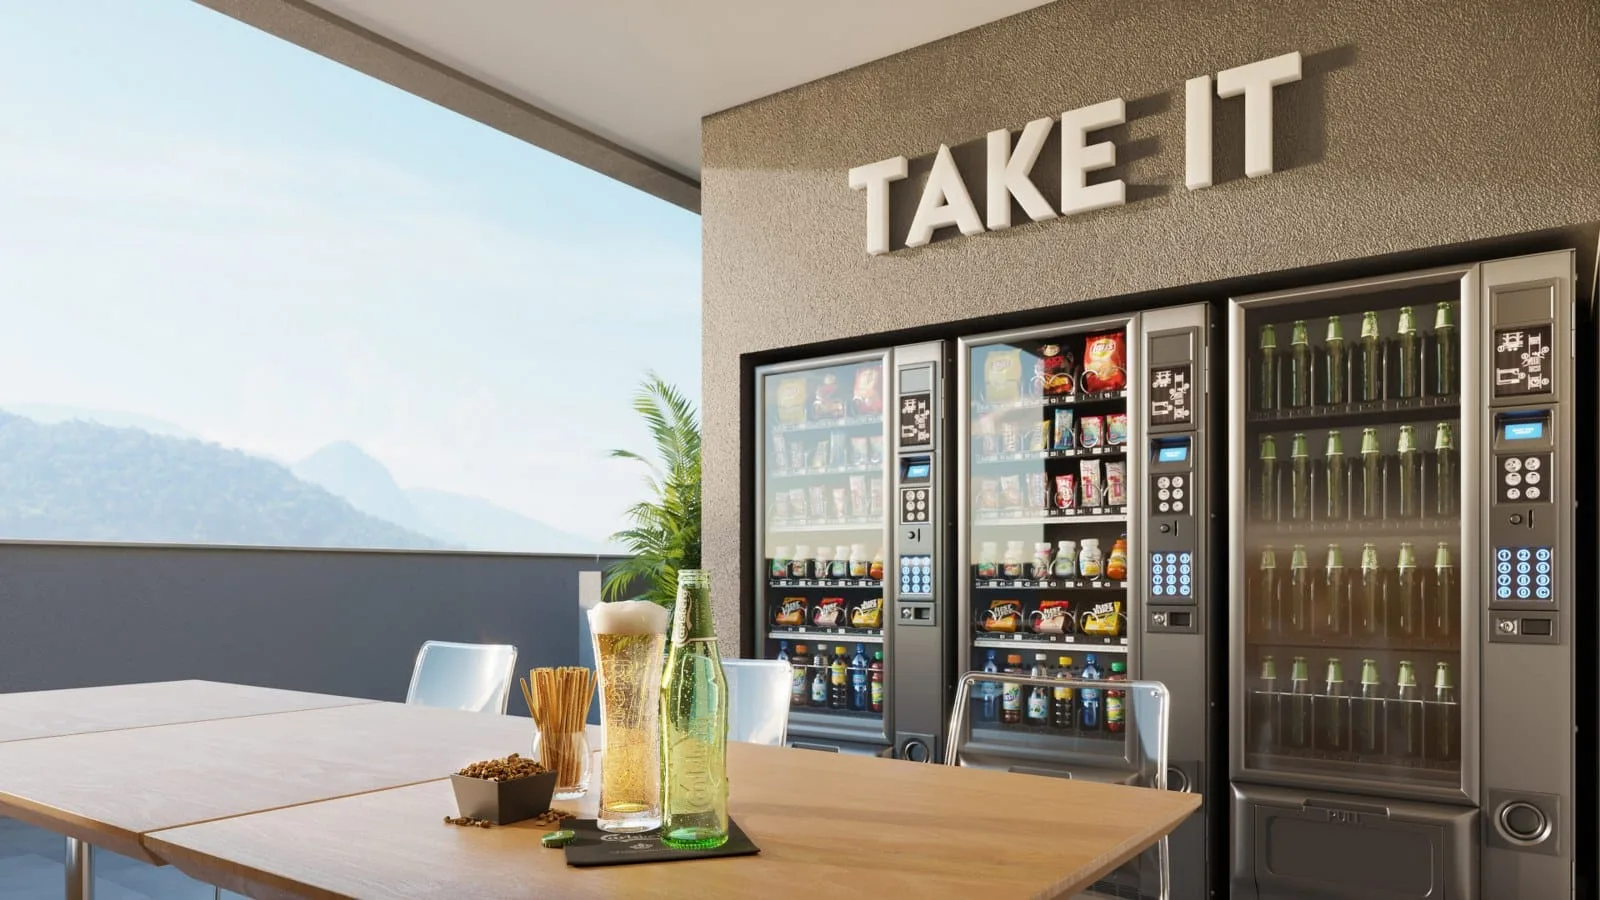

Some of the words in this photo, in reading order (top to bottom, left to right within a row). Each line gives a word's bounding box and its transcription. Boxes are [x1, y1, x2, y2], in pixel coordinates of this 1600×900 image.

[849, 97, 1127, 256] TAKE
[1185, 51, 1303, 191] IT
[1326, 808, 1363, 825] PULL
